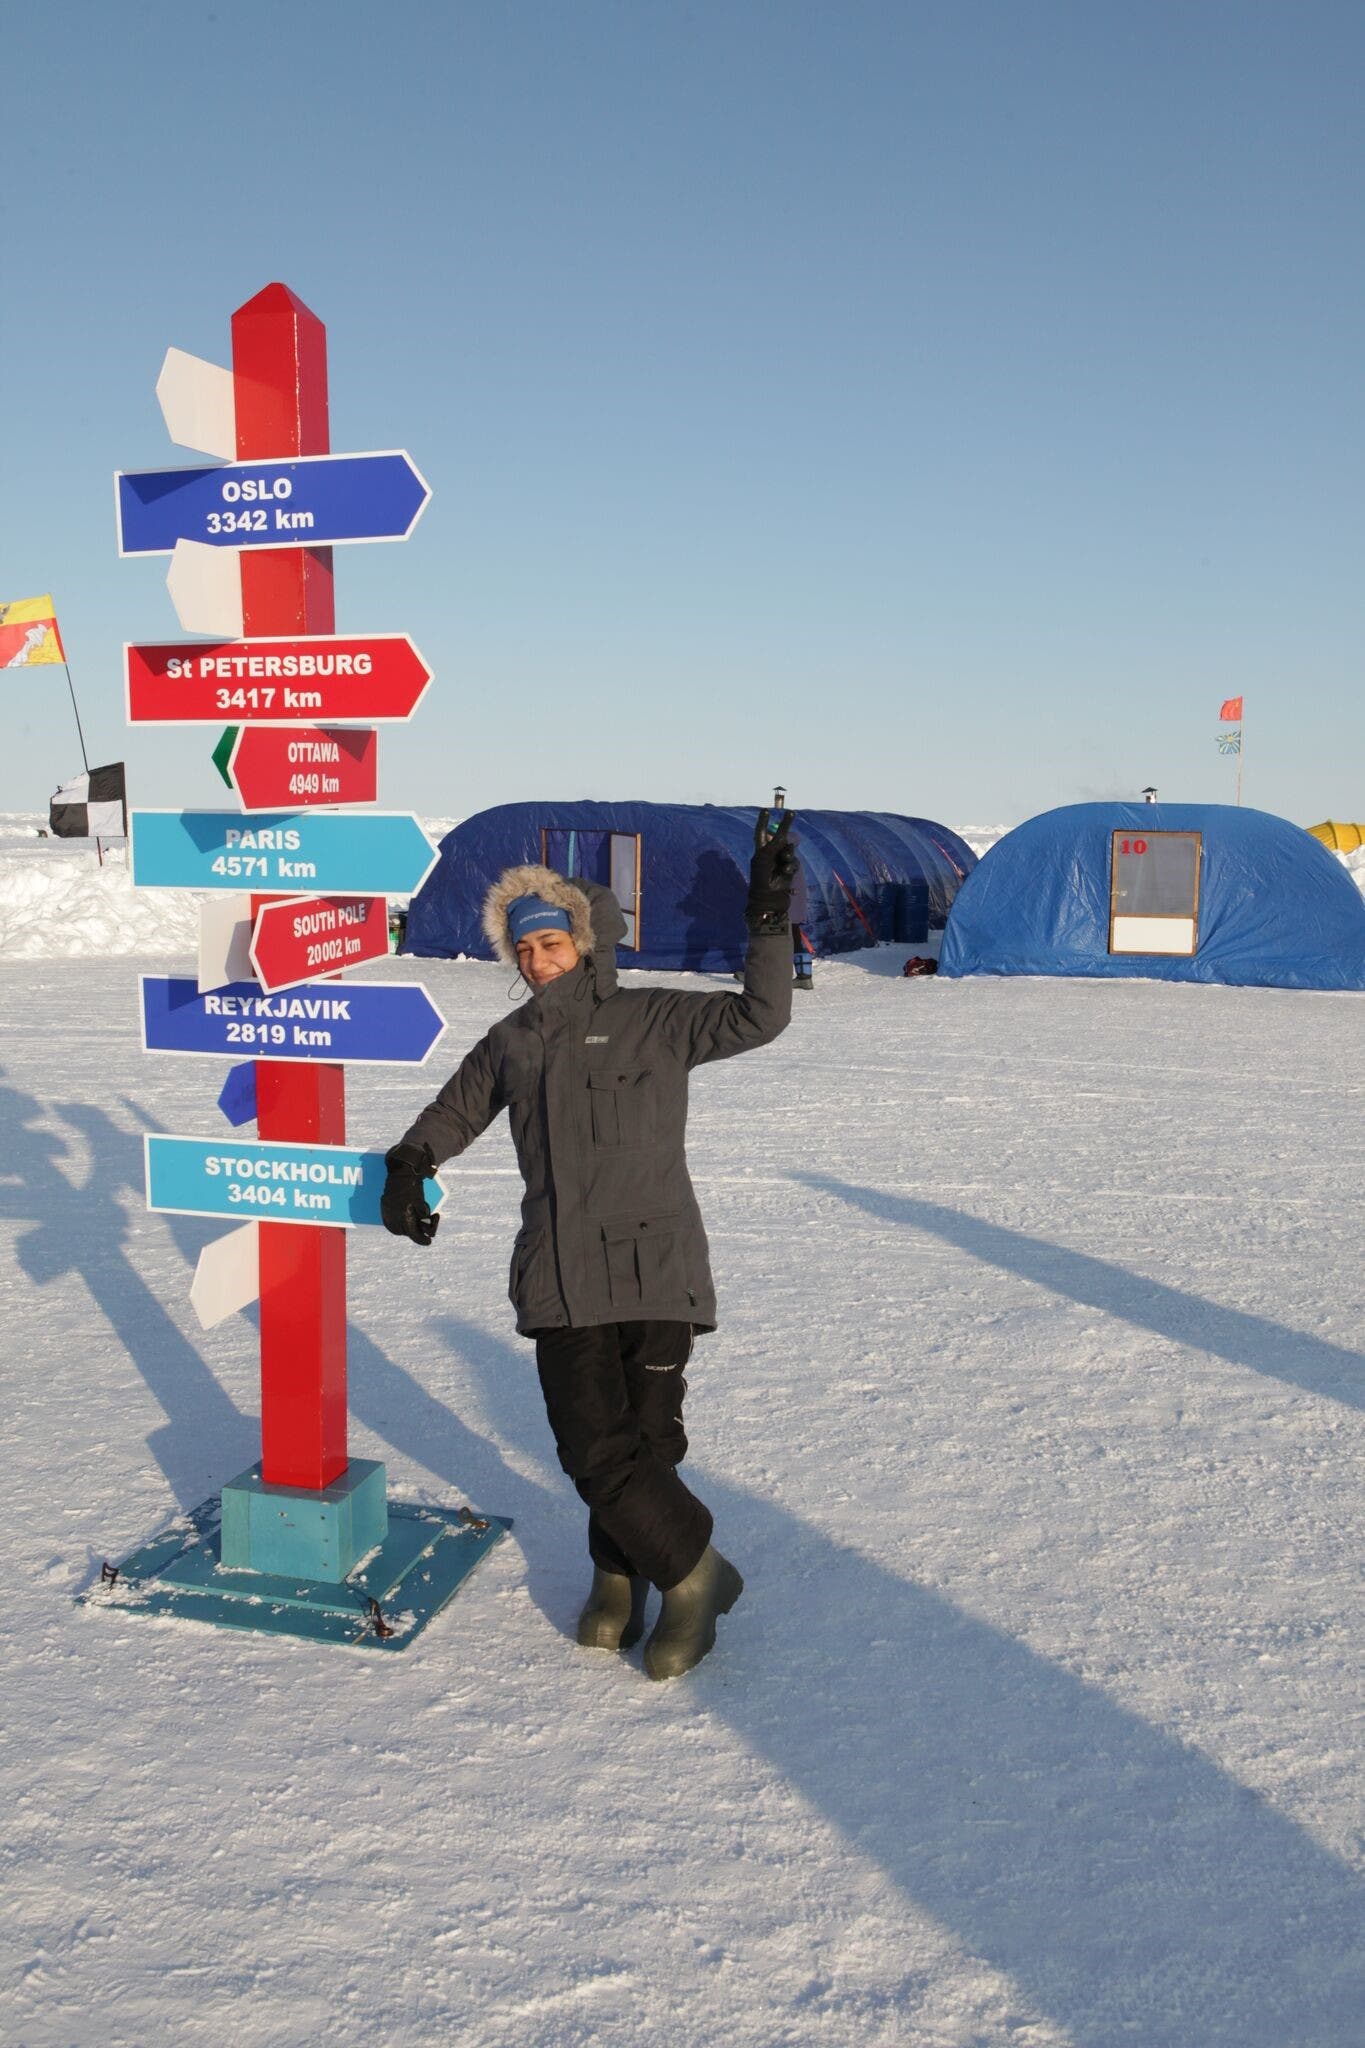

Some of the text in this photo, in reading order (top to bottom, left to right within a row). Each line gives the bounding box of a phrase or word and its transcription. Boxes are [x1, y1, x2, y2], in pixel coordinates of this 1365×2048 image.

[222, 478, 292, 502] OSLO
[207, 509, 314, 533] 3342 km
[167, 654, 372, 679] St PETERSBURG
[216, 688, 322, 709] 3417 km
[288, 742, 340, 763] OTTAWA
[289, 773, 340, 795] 4949 km
[226, 829, 300, 850] PARIS
[1121, 839, 1147, 855] 10
[212, 856, 316, 878] 4571 km
[293, 903, 366, 938] SOUTH POLE
[345, 936, 361, 956] km
[205, 996, 351, 1020] REYKJAVIK
[227, 1023, 332, 1046] 2819 km
[205, 1157, 363, 1186] STOCKHOLM
[228, 1184, 331, 1210] 3404 km
